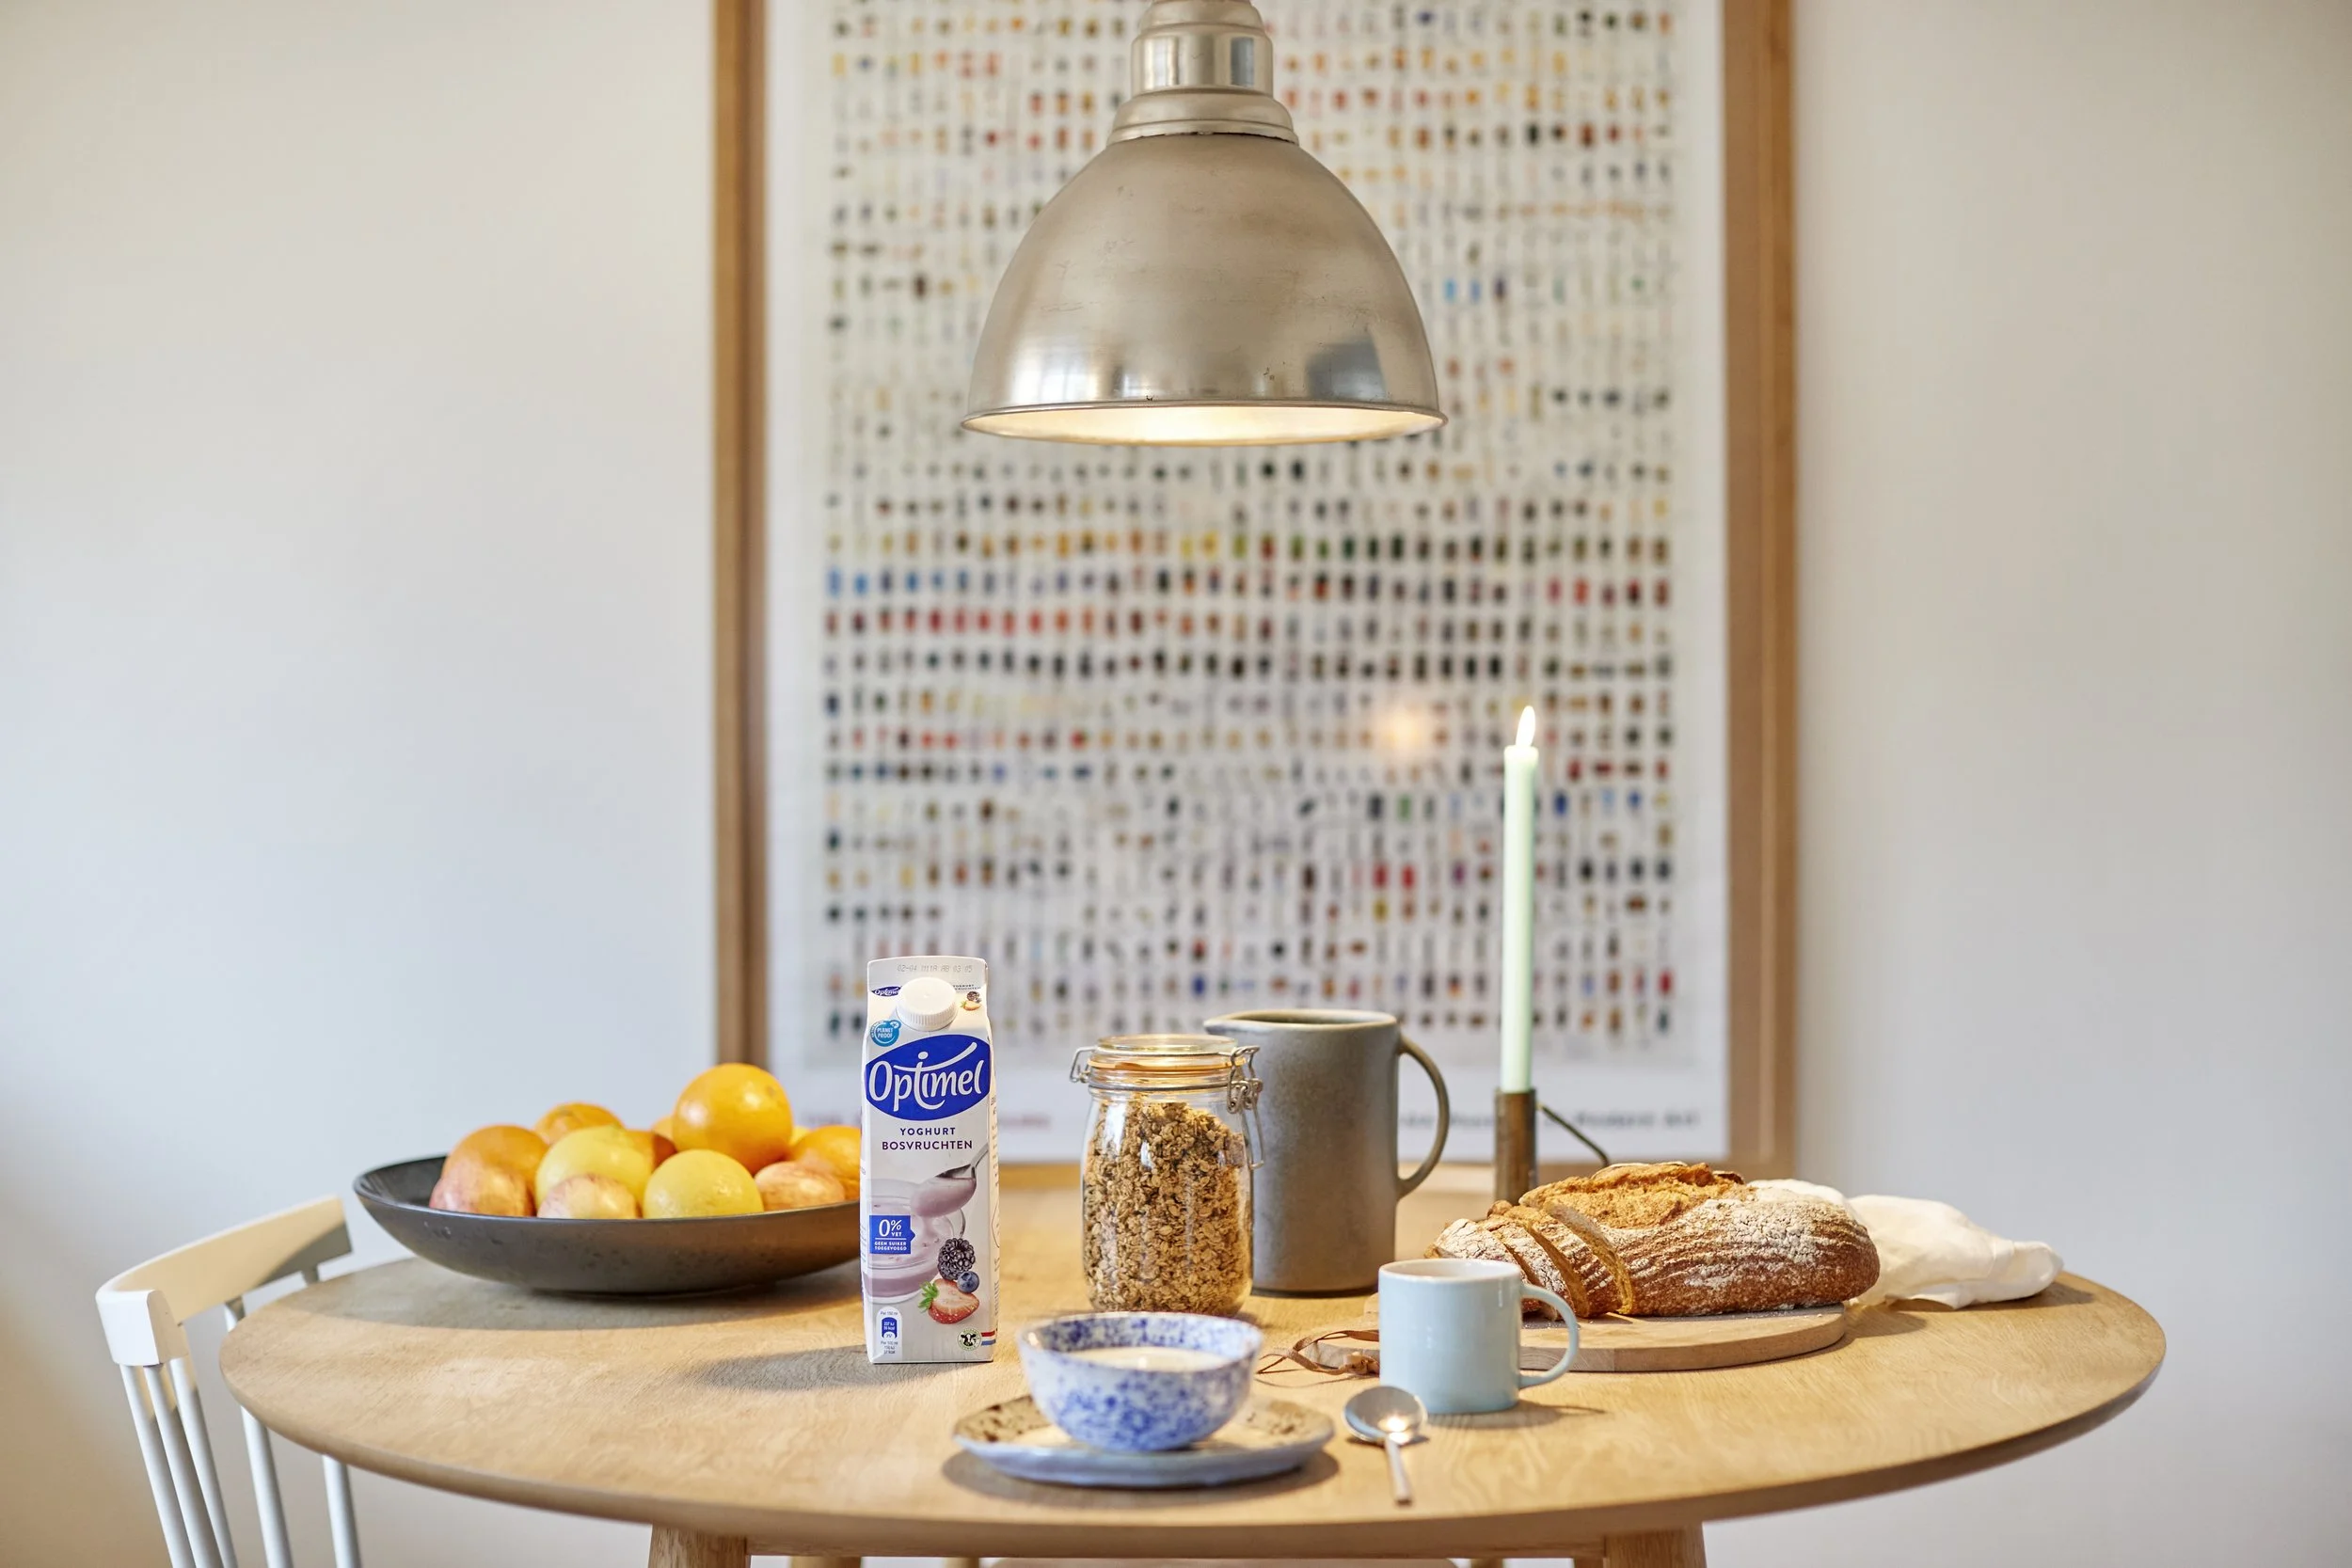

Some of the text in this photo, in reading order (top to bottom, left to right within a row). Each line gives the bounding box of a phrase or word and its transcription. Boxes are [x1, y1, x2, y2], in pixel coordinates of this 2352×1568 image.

[868, 1041, 984, 1112] Optimel
[899, 1127, 956, 1136] YOGHURT
[882, 1140, 973, 1150] BOSVRUCHTEN
[879, 1219, 902, 1237] 0%
